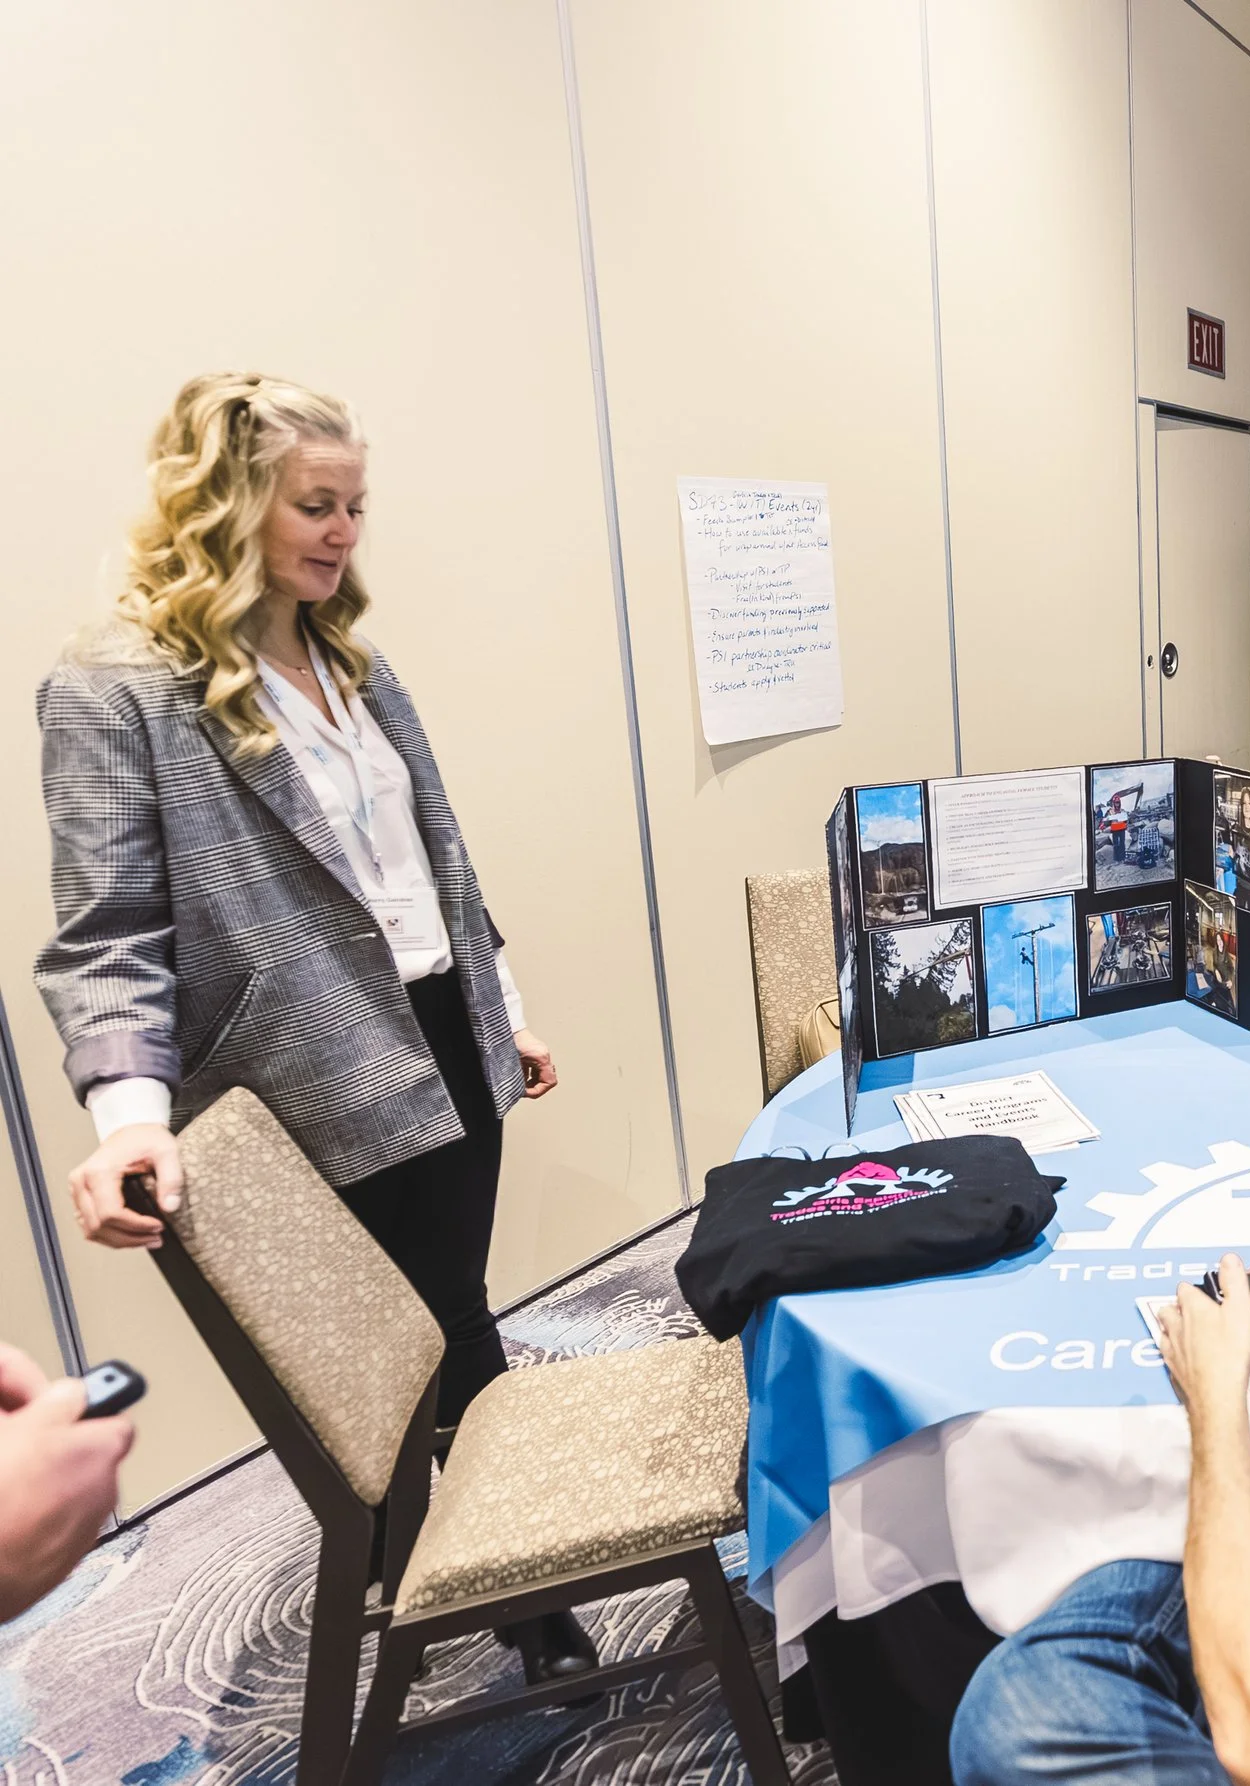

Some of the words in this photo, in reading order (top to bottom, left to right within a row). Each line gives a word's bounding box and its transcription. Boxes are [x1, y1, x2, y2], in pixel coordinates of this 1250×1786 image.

[1194, 320, 1219, 367] EXIT
[769, 499, 799, 512] Events
[712, 679, 748, 693] Students
[945, 1108, 985, 1118] Career
[990, 1098, 1048, 1111] Programs
[970, 1096, 1013, 1107] District
[969, 1114, 991, 1122] and
[995, 1107, 1036, 1118] Events
[974, 1114, 1040, 1129] Handbook
[1050, 1261, 1220, 1282] Trade
